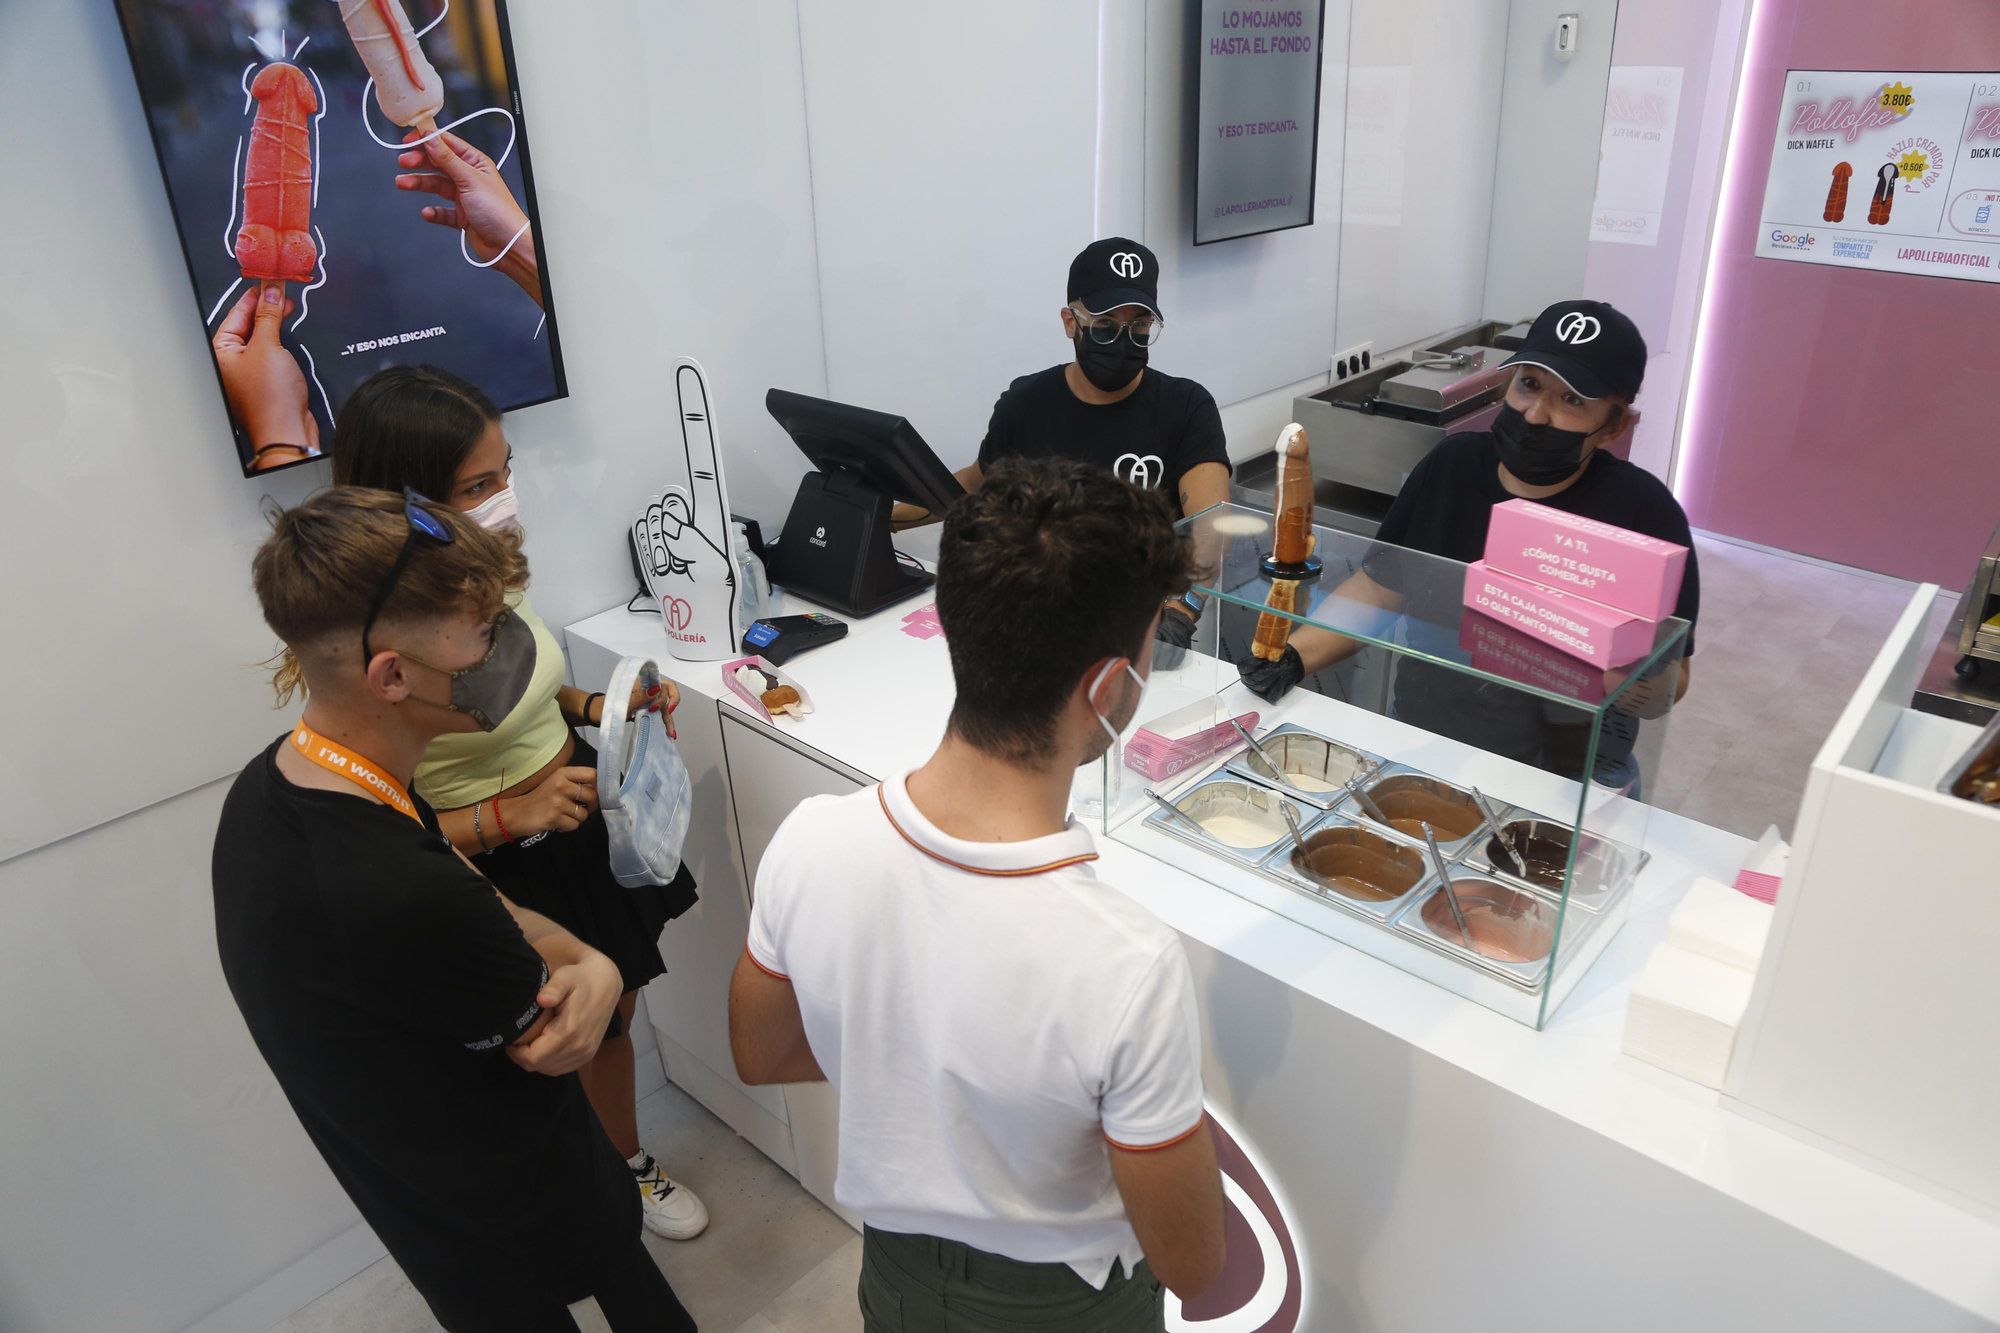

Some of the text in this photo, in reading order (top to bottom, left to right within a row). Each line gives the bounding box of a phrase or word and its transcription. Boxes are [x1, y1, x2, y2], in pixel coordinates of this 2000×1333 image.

[1223, 10, 1303, 29] LO MOJAMOS
[1210, 37, 1251, 55] HASTA
[1254, 37, 1268, 54] EL
[1271, 36, 1311, 53] FONDO
[1883, 94, 1912, 106] 3.80€
[1978, 85, 1997, 97] 0.2
[1789, 98, 1893, 141] Pollofre
[1218, 120, 1299, 139] Y ESO TE ENCANTA.
[1787, 139, 1835, 150] DICK WAFFLE
[1971, 148, 1991, 159] DICK
[1886, 137, 1943, 189] HAZLO CREMOSO POR
[1899, 162, 1924, 172] +0.50€
[1771, 229, 1816, 247] Google
[1833, 241, 1874, 253] COMPARTE TU
[1833, 249, 1870, 260] EXPERIENCIA
[1897, 248, 1991, 268] LAPOLLERIAOFICIAL
[356, 340, 377, 353] ESO
[378, 335, 400, 348] NOS
[399, 326, 447, 343] ENCANTA
[1555, 534, 1589, 554] Y A TI,
[1522, 547, 1617, 583] ¿CÓMO TE GUSTA
[1538, 564, 1597, 589] COMERLA?
[1484, 583, 1590, 637] ESTA CAJA CONTIENE
[1476, 594, 1595, 655] LO QUE TANTO MERECES
[350, 762, 401, 804] WORTH
